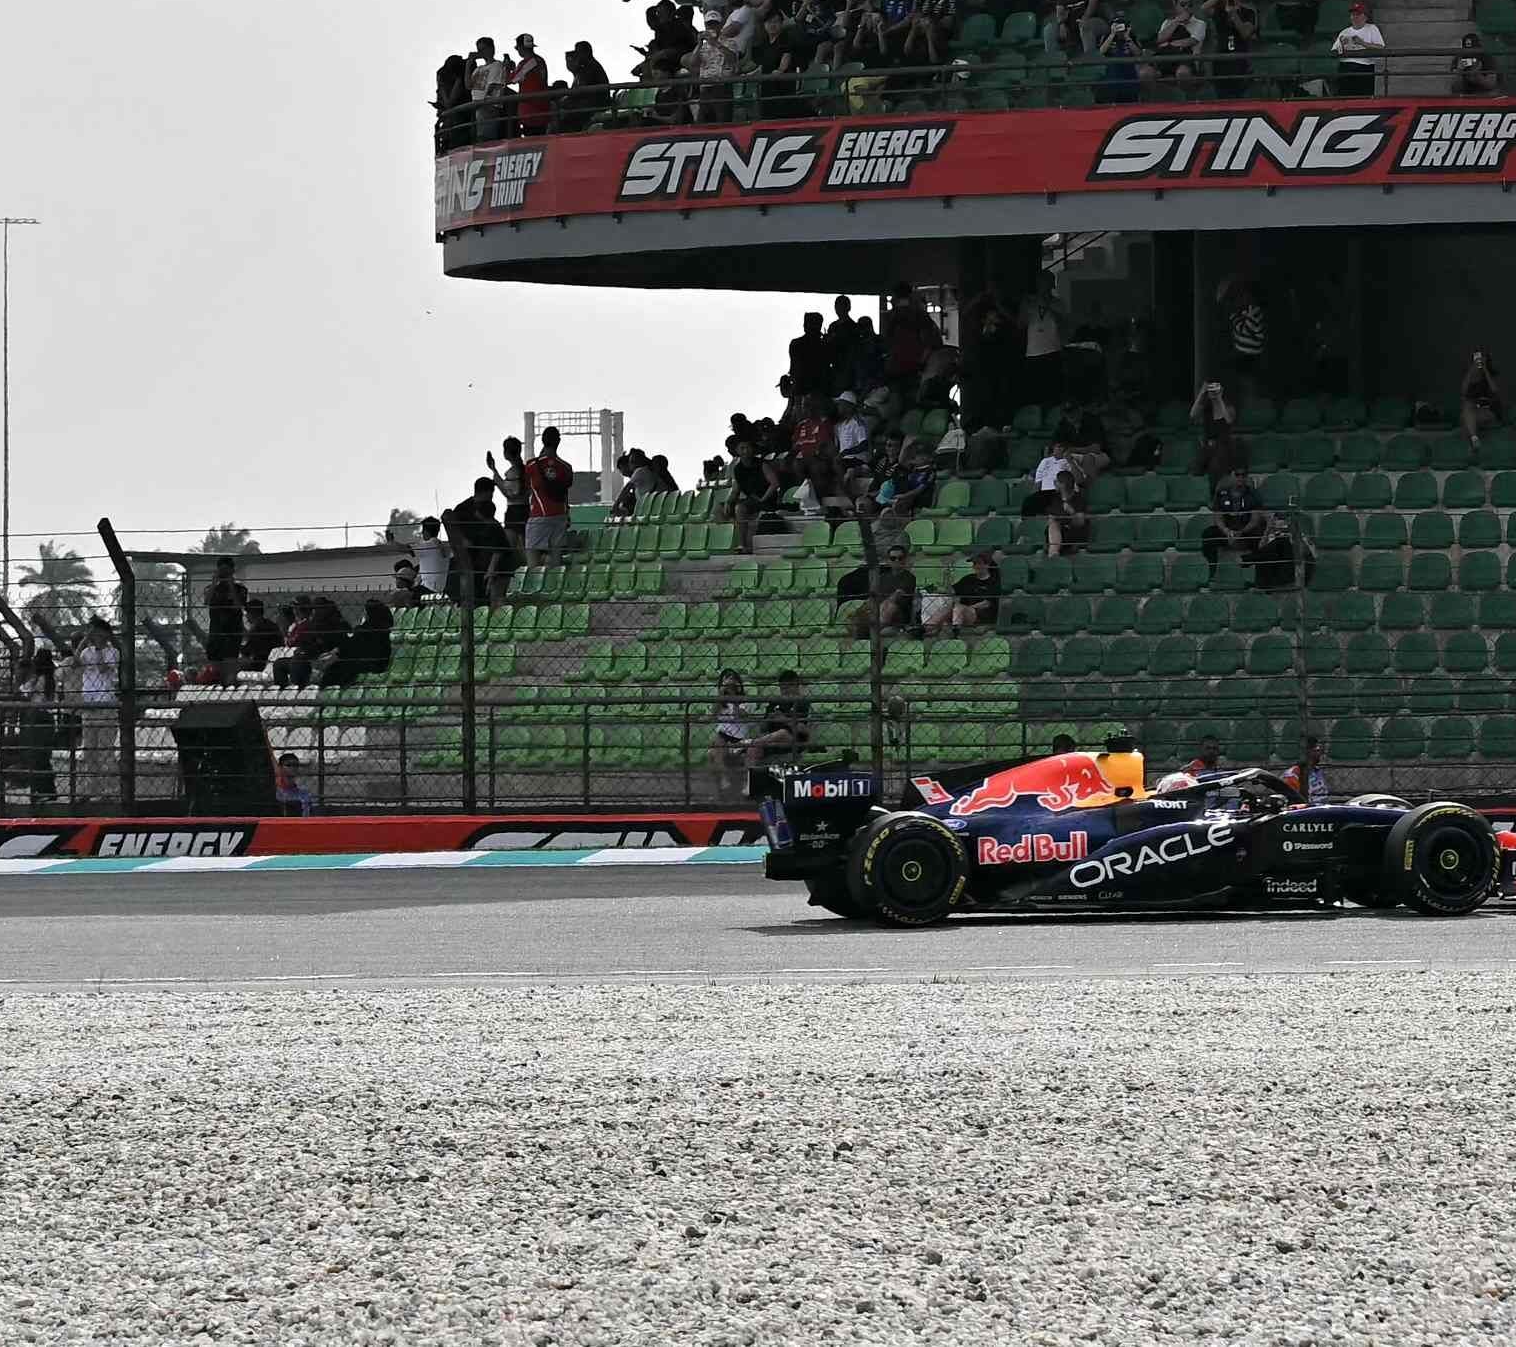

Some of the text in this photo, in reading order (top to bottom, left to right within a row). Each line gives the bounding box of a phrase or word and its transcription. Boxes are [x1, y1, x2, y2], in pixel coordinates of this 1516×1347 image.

[836, 127, 947, 159] ENERGY
[1096, 113, 1384, 175] STING
[1398, 139, 1507, 167] DRINK
[494, 152, 543, 183] ENERGY
[621, 135, 816, 195] STING
[826, 155, 912, 186] DRINK
[490, 178, 526, 208] DRINK
[793, 779, 849, 799] Mobil
[1283, 823, 1334, 832] CARLYLE
[978, 835, 1033, 864] Red
[1034, 831, 1089, 861] Bull
[1069, 822, 1236, 888] ORACLE
[1267, 878, 1317, 893] indeed
